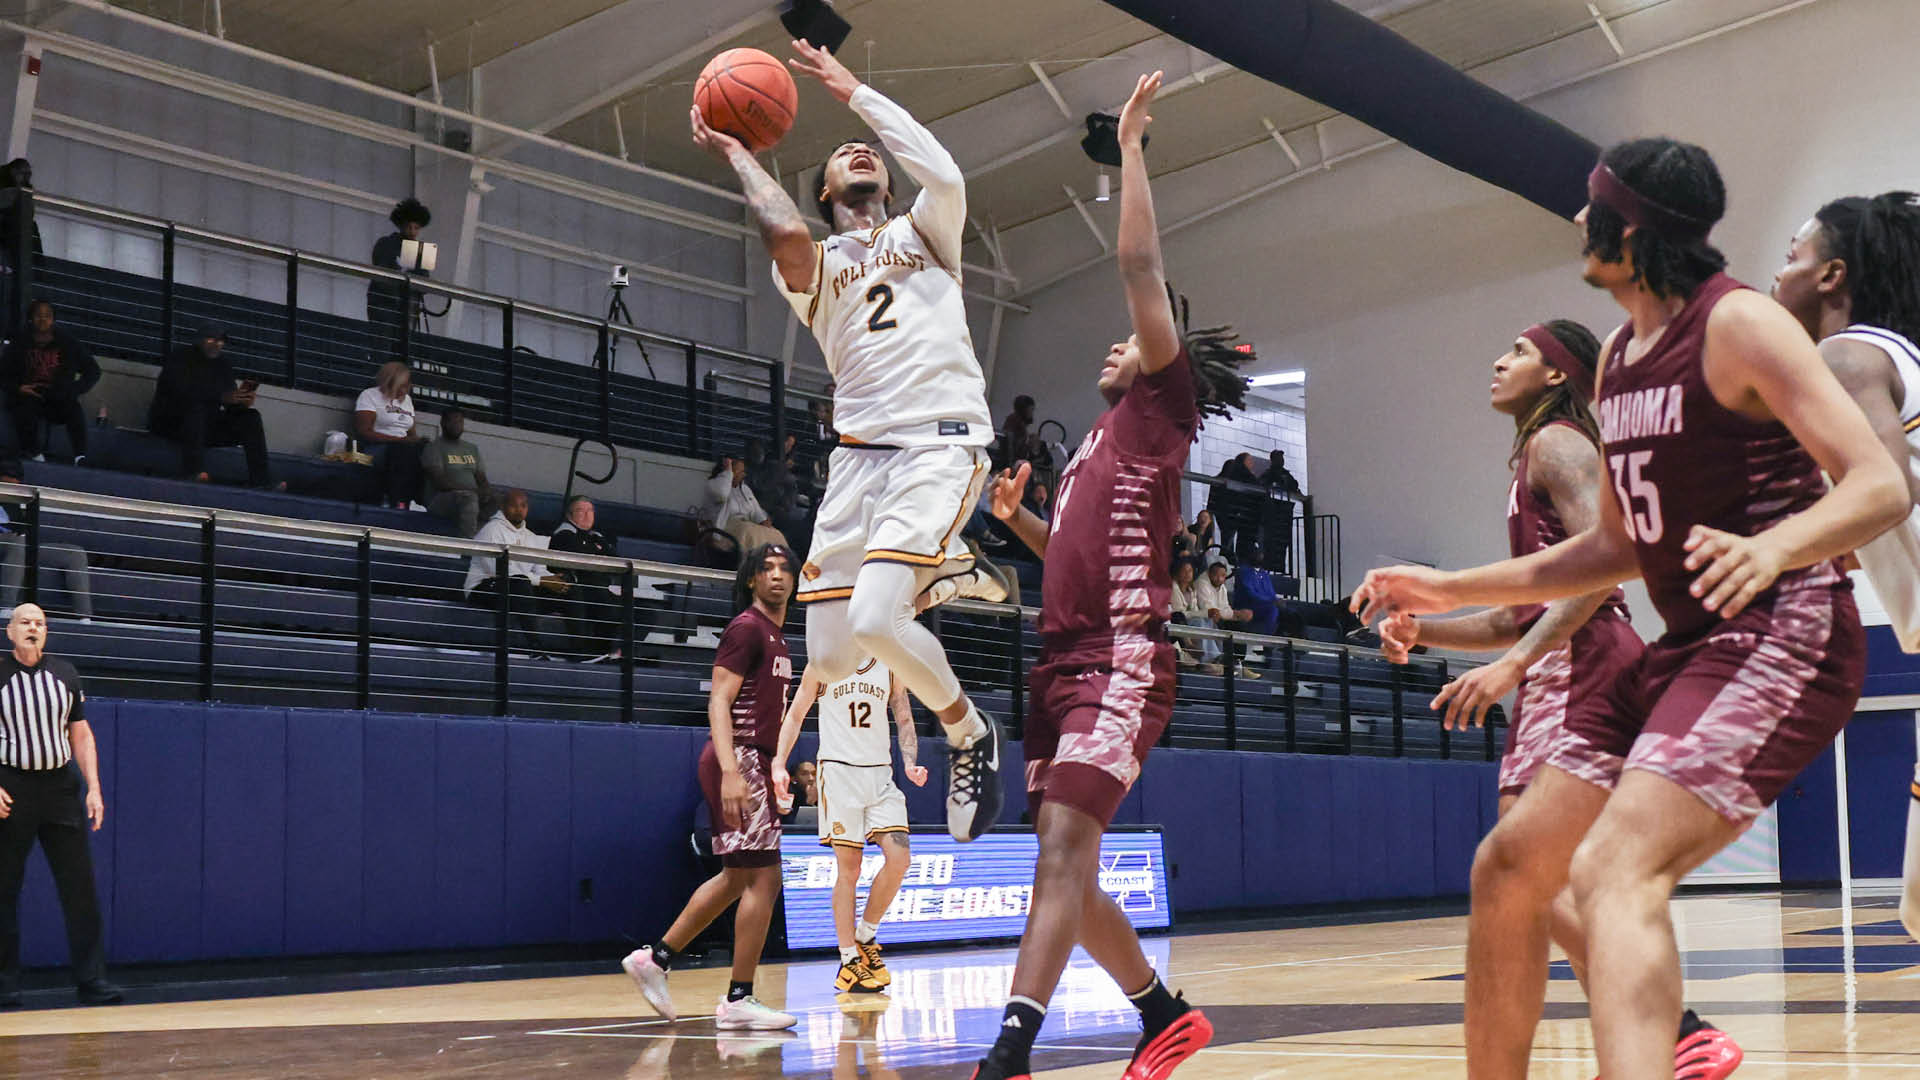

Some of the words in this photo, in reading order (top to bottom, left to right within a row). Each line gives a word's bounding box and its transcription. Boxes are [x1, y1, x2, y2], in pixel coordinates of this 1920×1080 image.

[866, 283, 898, 332] 2
[1600, 384, 1683, 444] OAHOMA
[833, 681, 857, 699] GULF
[858, 681, 886, 700] COAST
[848, 702, 871, 728] 12
[914, 854, 955, 885] TO
[1106, 876, 1147, 886] COAST
